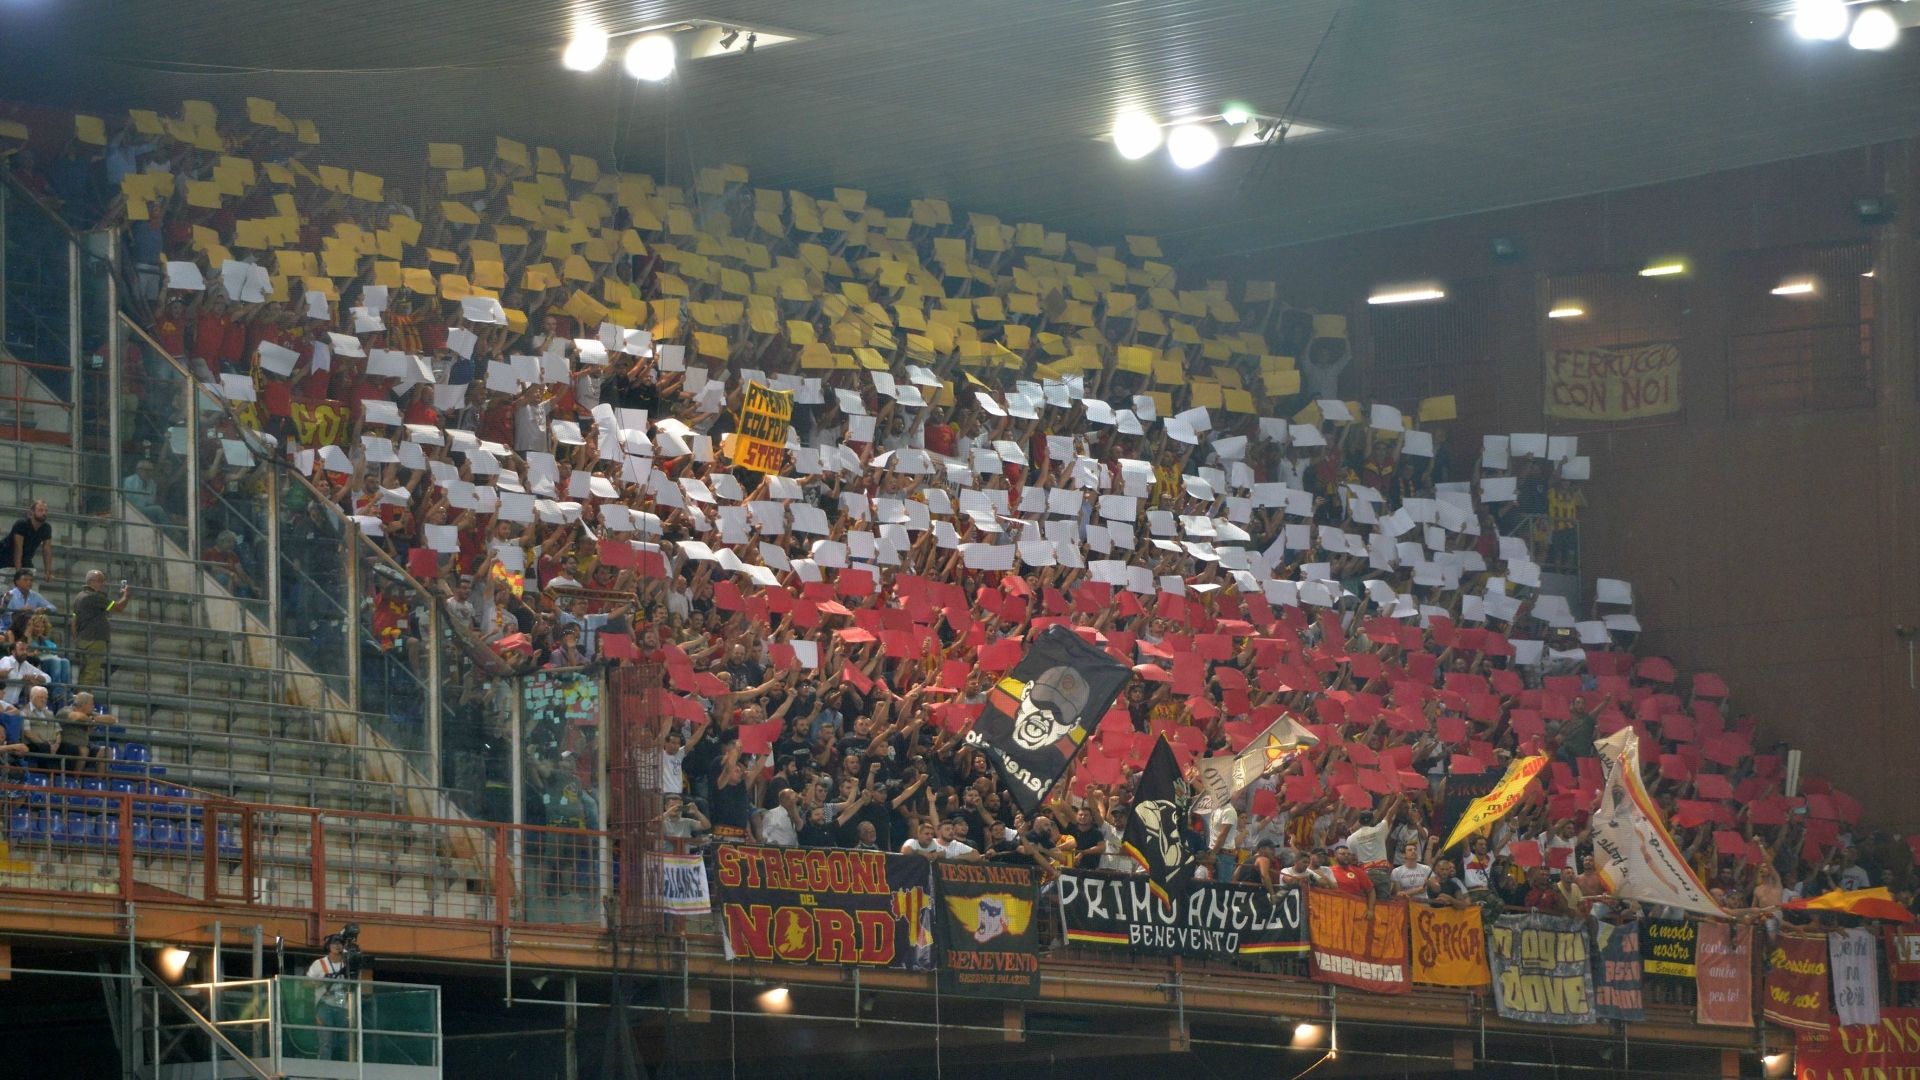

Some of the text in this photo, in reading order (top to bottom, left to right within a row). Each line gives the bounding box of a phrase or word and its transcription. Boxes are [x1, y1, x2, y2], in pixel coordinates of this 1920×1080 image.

[1553, 375, 1669, 413] CON NOI
[717, 844, 891, 895] STREGONI
[939, 863, 1032, 887] TESTE MATTE
[800, 893, 819, 906] DEL
[1059, 874, 1177, 924] PRIMO
[1188, 887, 1300, 931] ANELLO
[723, 902, 897, 965] NORD
[1129, 924, 1239, 954] BENEVENTO
[1660, 920, 1694, 940] modo
[947, 949, 1038, 973] BENEVENTO
[1652, 942, 1689, 959] nostro
